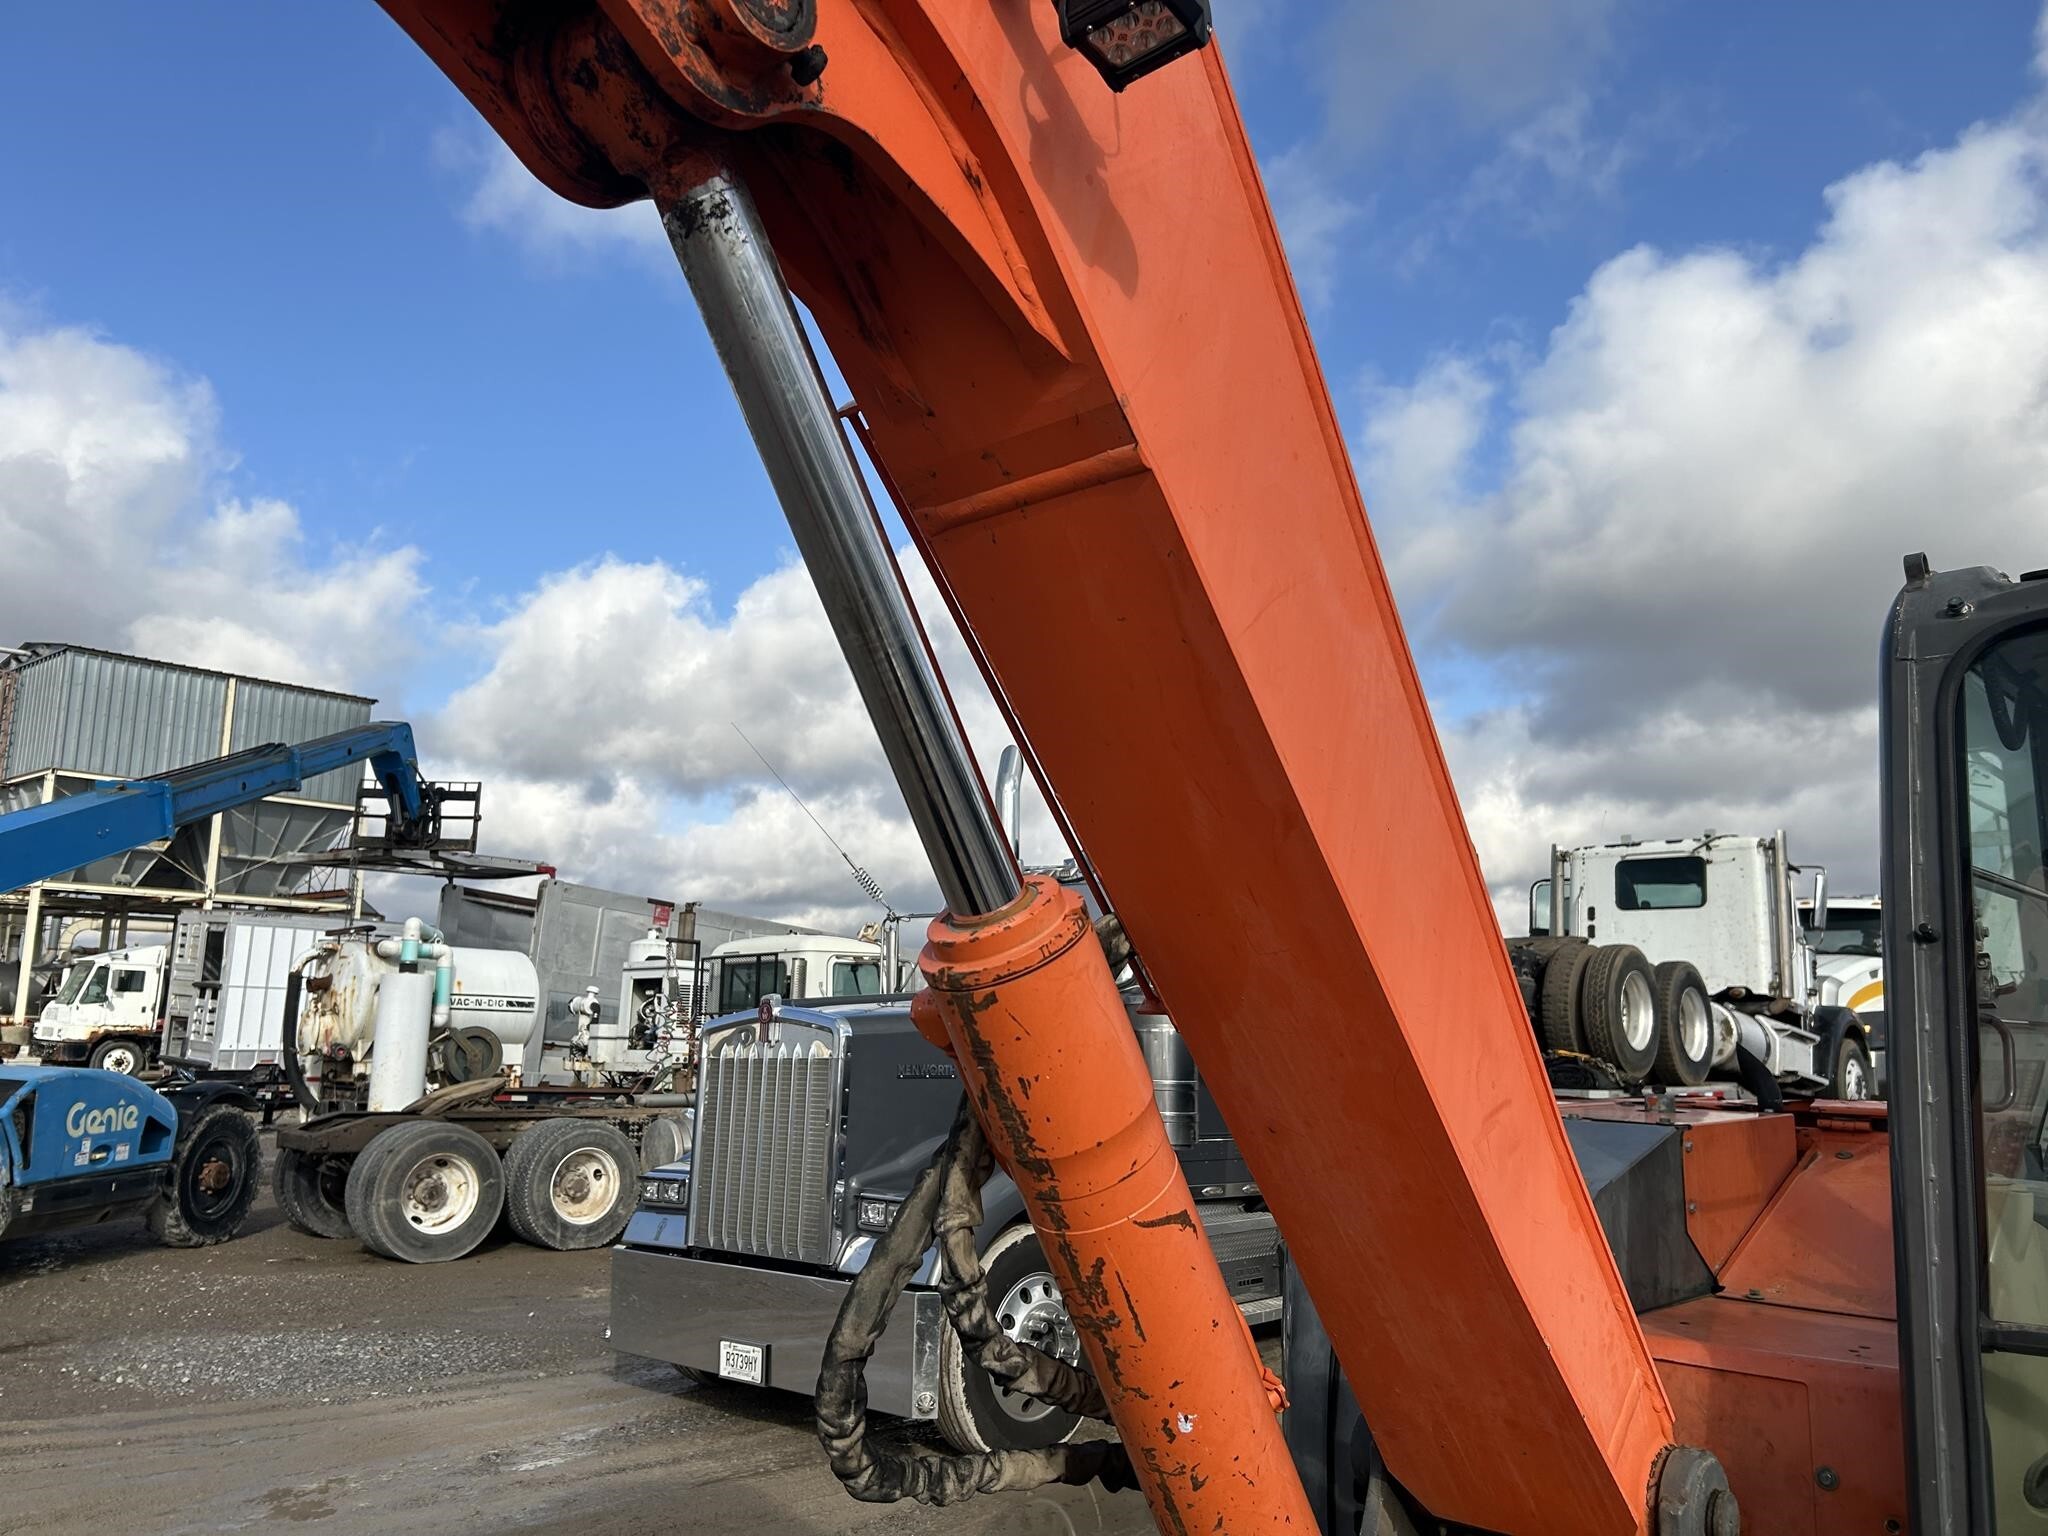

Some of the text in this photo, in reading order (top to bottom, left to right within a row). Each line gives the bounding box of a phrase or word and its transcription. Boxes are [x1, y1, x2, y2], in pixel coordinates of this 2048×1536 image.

[450, 998, 504, 1007] VAC-N-DIG
[66, 1099, 138, 1138] Genie
[726, 1351, 757, 1372] R3739HY
